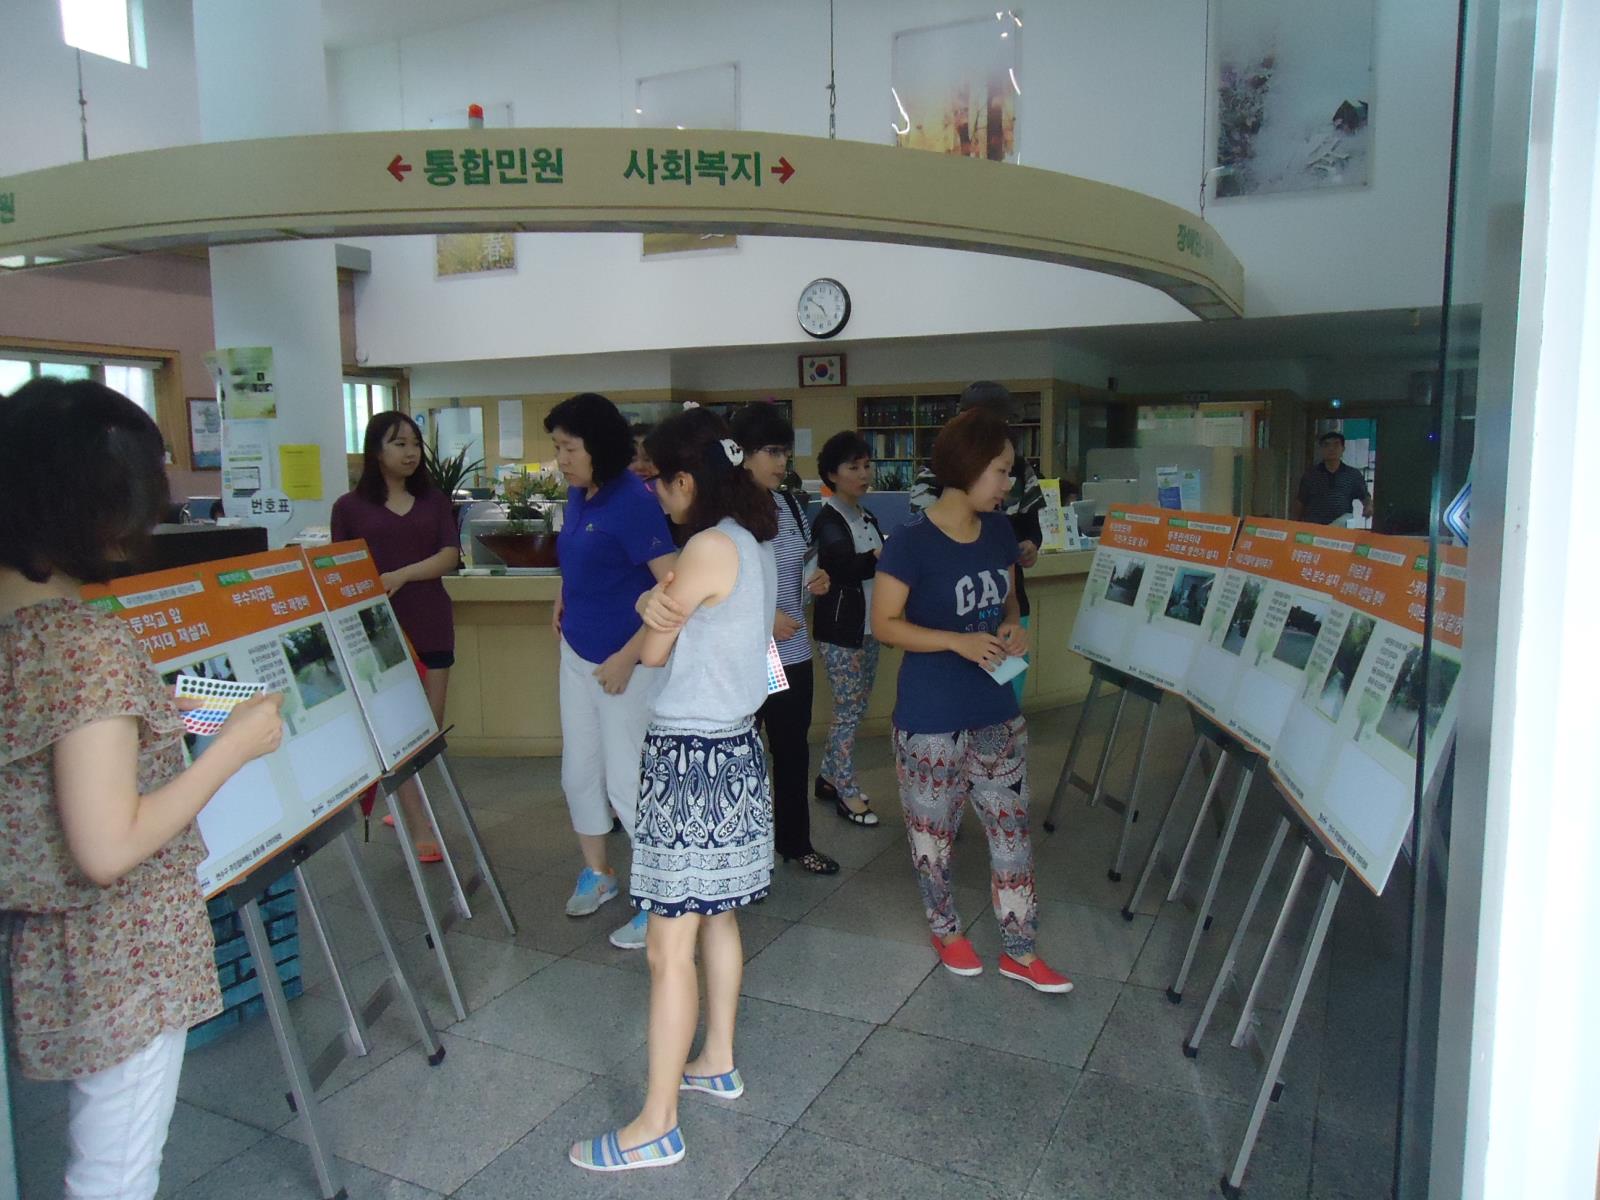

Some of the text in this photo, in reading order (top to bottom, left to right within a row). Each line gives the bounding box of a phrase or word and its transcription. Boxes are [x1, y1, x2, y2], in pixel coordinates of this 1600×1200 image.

[423, 148, 564, 187] 통합민원
[623, 148, 762, 187] 사회복지
[251, 498, 290, 515] 번호표
[168, 607, 182, 624] 앞
[176, 622, 211, 643] 재설치
